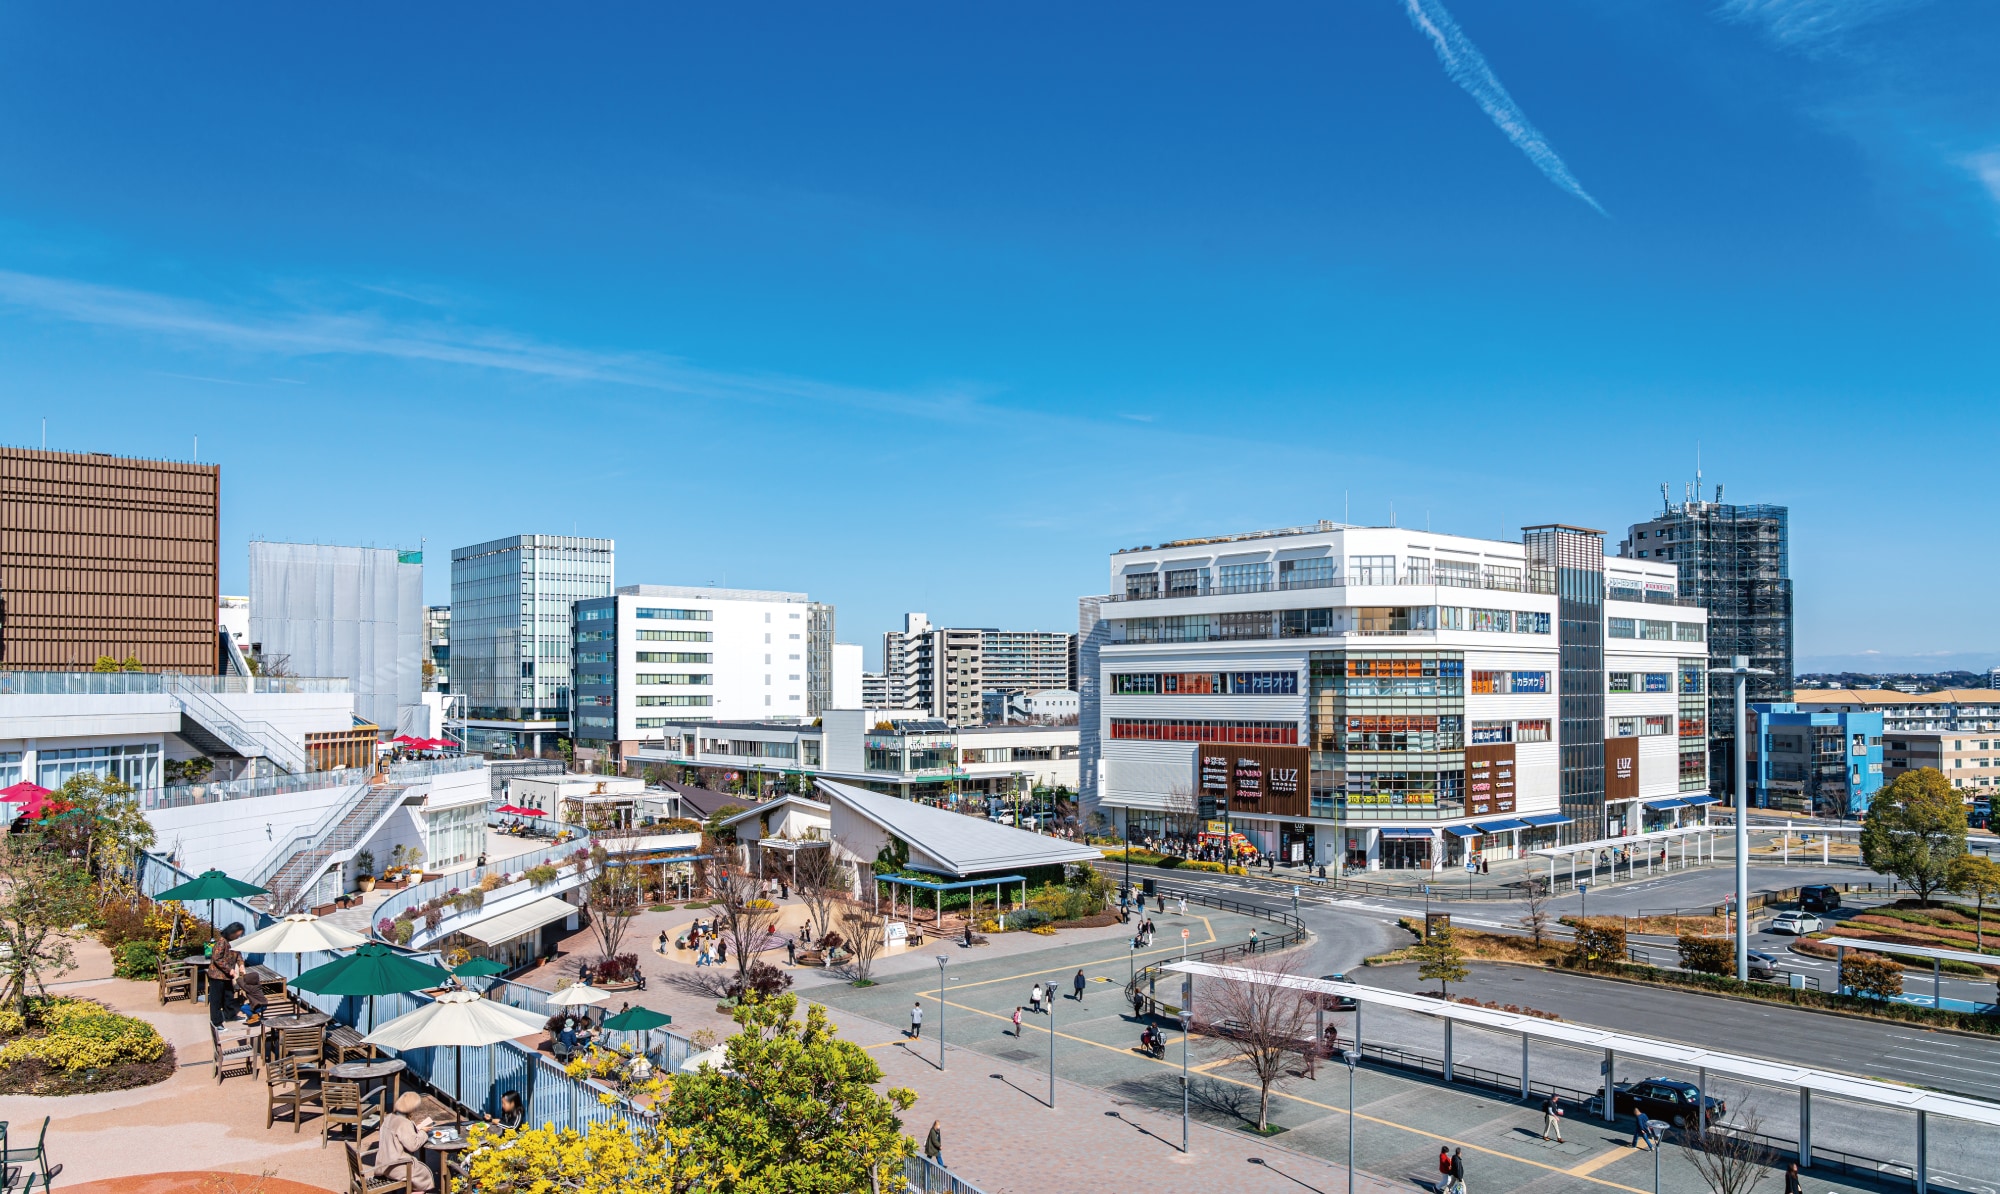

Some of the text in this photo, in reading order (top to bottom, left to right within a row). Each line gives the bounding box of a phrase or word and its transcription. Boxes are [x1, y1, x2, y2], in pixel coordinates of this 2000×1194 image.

[1252, 677, 1294, 688] カラオケ
[1517, 677, 1539, 687] カラオケ
[1616, 757, 1632, 770] LUZ
[1270, 767, 1298, 782] LUZ
